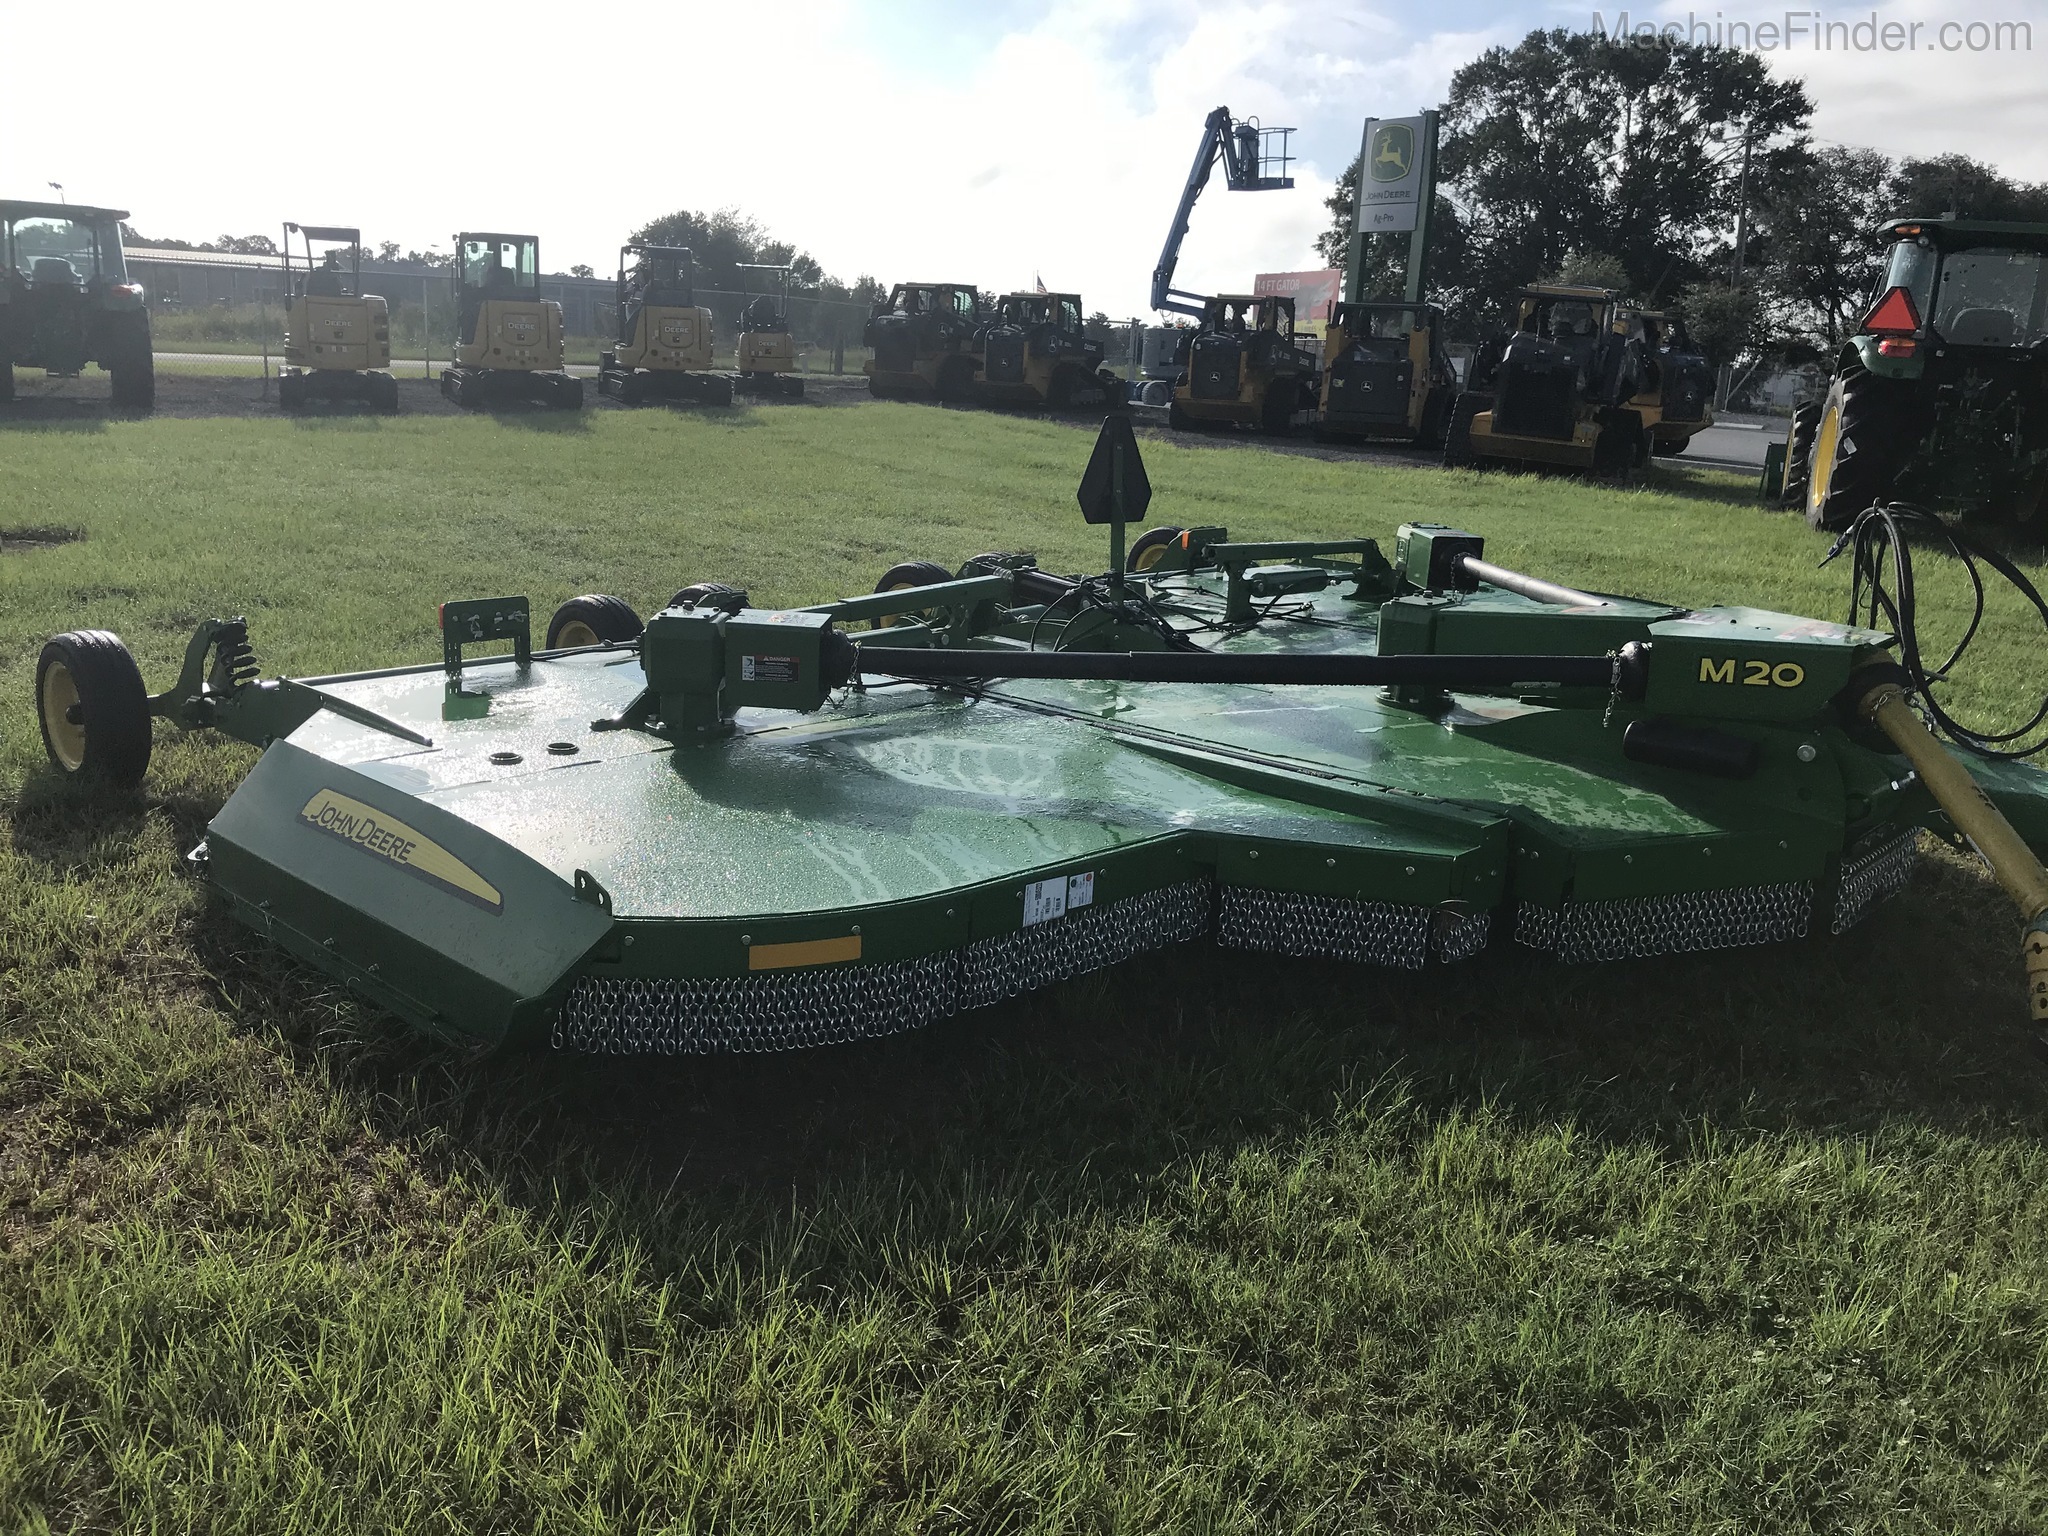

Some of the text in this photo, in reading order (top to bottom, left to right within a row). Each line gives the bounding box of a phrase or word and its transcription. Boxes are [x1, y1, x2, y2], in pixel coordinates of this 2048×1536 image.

[1384, 190, 1411, 199] DEERE
[1266, 280, 1276, 291] FT
[1276, 279, 1300, 290] GATOR
[508, 322, 536, 330] DEERE
[1699, 658, 1805, 687] M 20
[311, 801, 417, 863] JOHN DEERE
